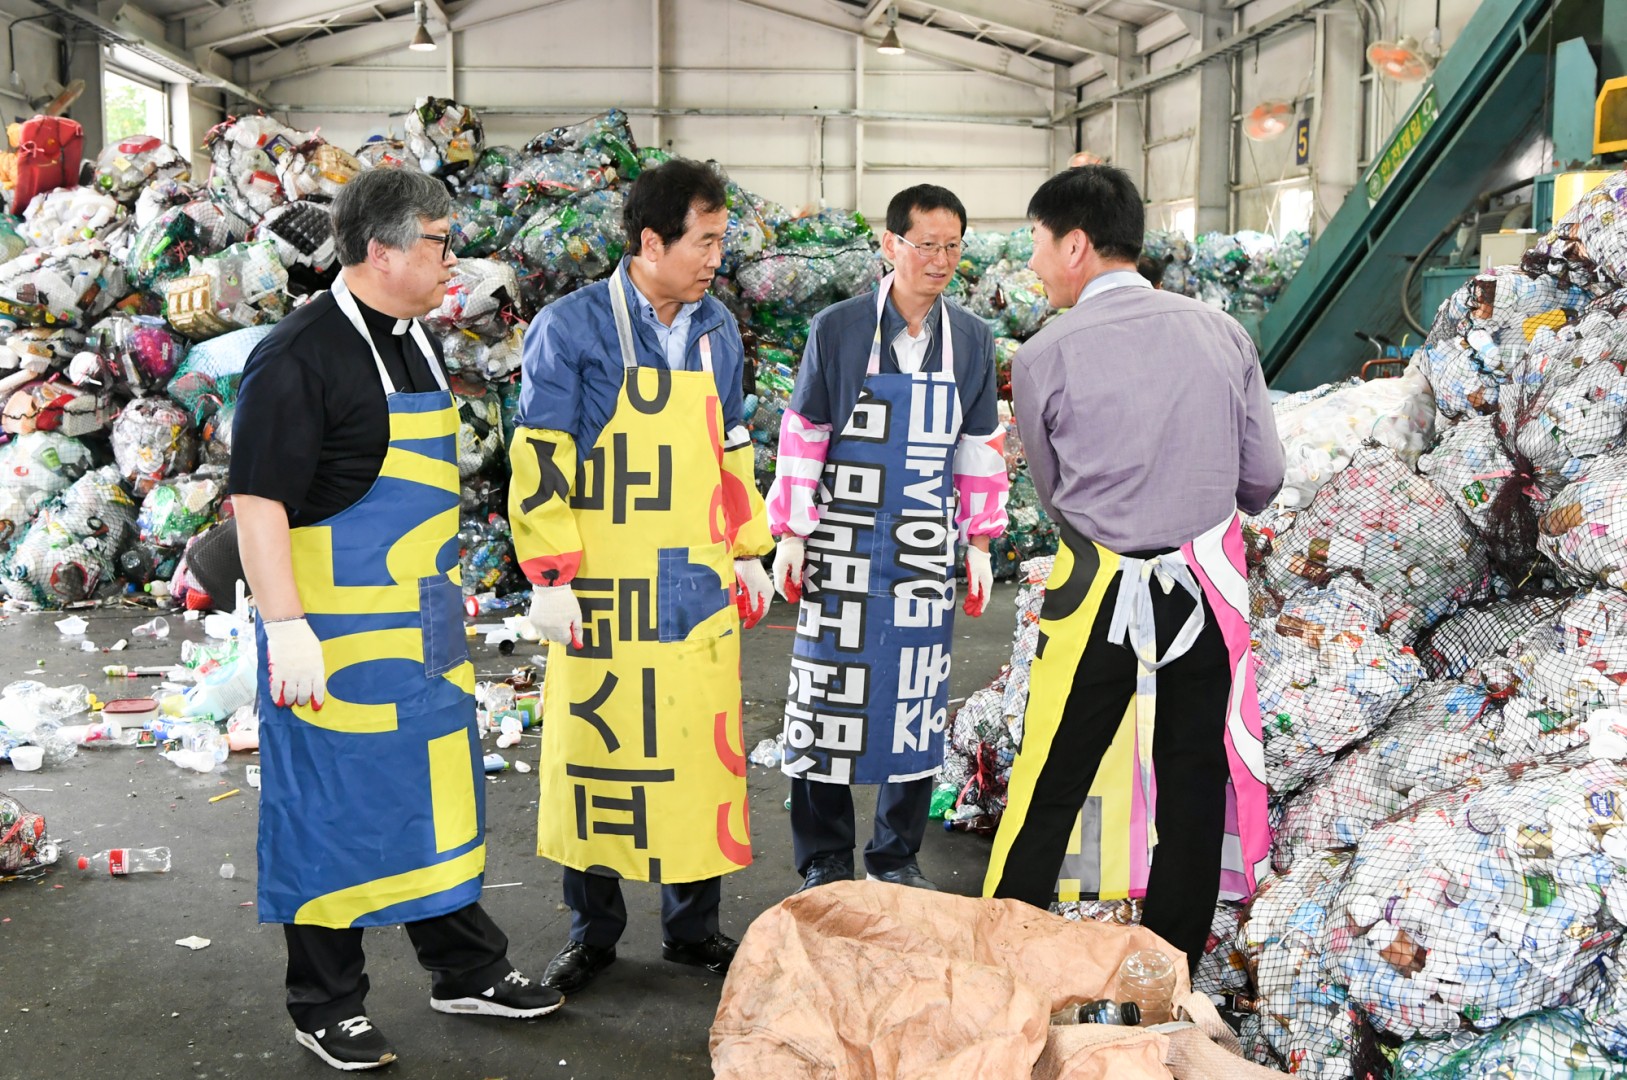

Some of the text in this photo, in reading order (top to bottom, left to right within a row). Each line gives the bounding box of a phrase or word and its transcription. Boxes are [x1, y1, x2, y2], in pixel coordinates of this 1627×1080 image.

[1298, 127, 1308, 157] 5
[1381, 113, 1422, 183] 안전제일
[566, 577, 675, 883] 피스텔
[891, 645, 951, 754] 중동
